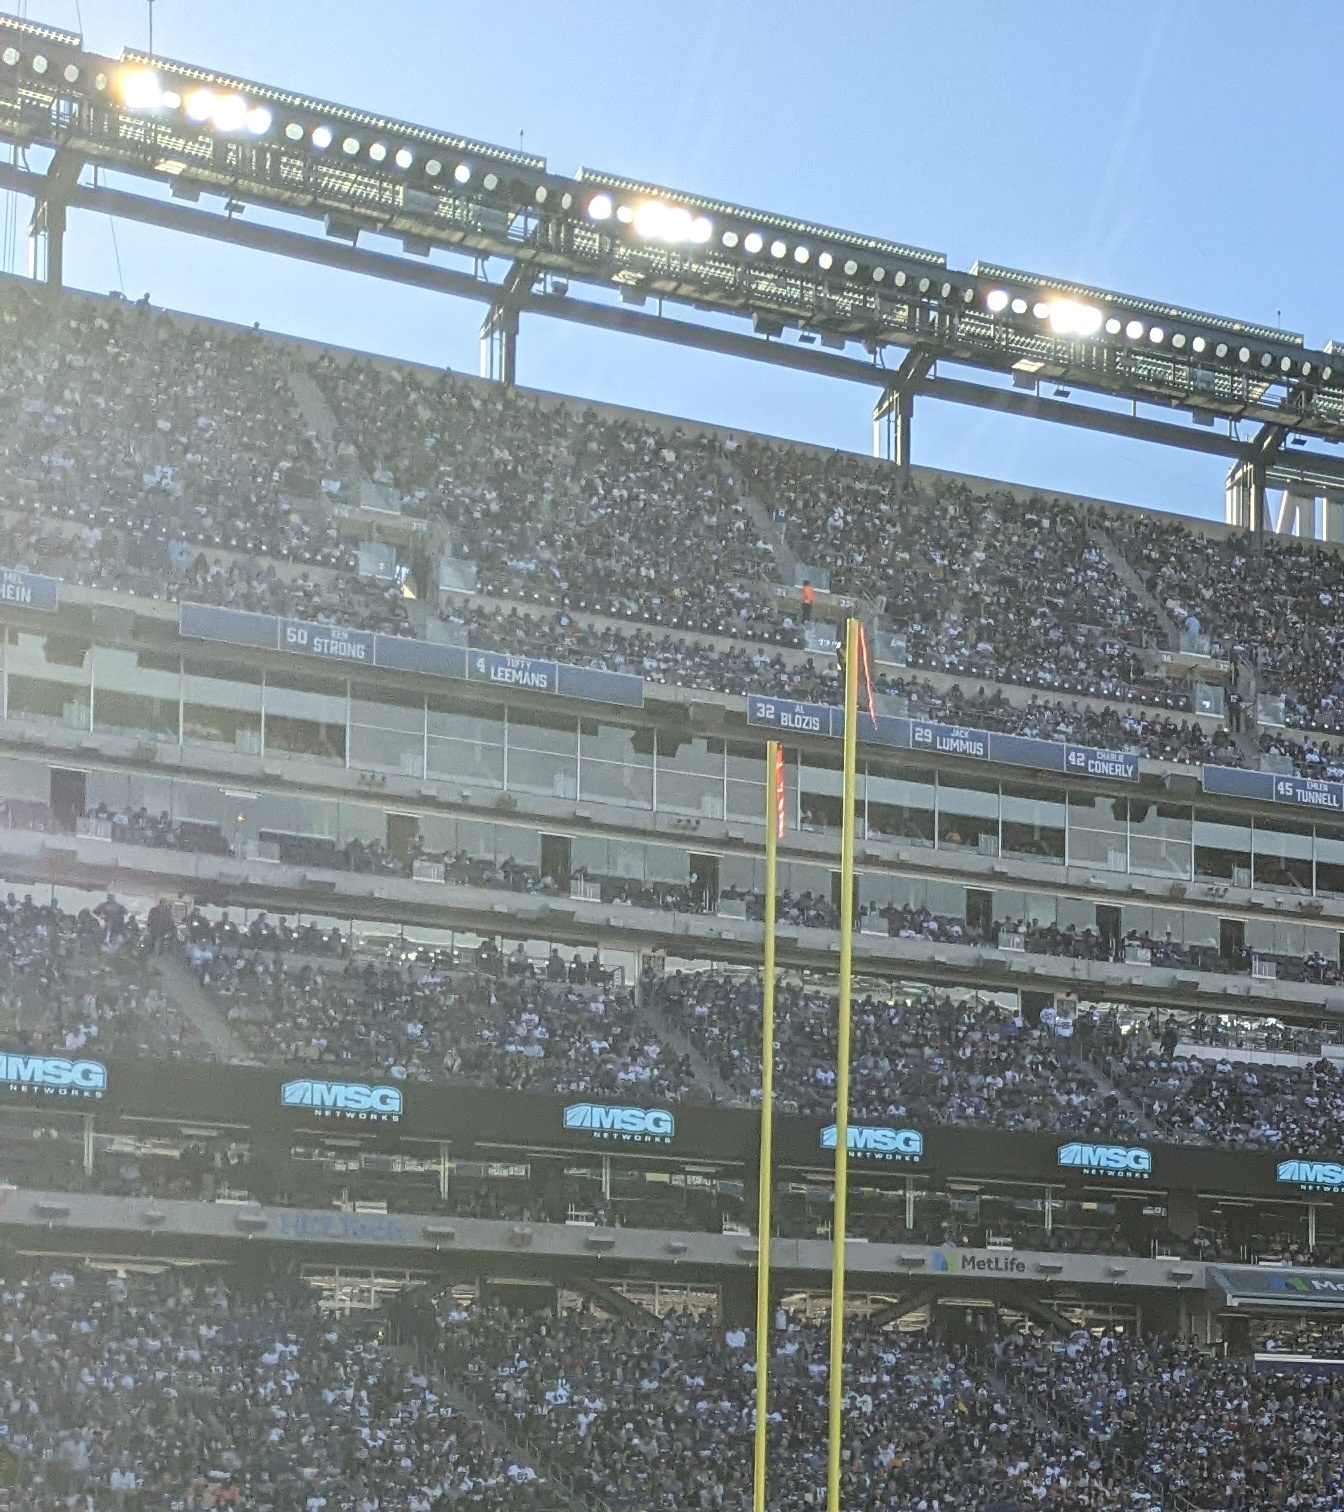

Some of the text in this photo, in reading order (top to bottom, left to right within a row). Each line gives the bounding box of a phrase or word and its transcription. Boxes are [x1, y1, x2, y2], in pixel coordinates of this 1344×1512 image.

[313, 638, 366, 660] STRONG
[476, 657, 486, 673] 4
[490, 668, 548, 688] LEEMANS
[756, 702, 775, 719] 32
[780, 713, 820, 731] BLOZIS
[914, 727, 932, 743] 29
[936, 736, 984, 756] LUMMUS
[1068, 751, 1086, 767] 42
[1087, 759, 1134, 778] CONERLY
[1277, 781, 1293, 795] 45
[1296, 788, 1340, 807] TUNNELL
[5, 1054, 105, 1089] MSG
[9, 1084, 103, 1099] NETWORKS
[309, 1081, 402, 1113] MSG
[313, 1109, 400, 1123] NETWORKS
[591, 1106, 674, 1135] MSG
[592, 1131, 672, 1144] NETWORKS
[846, 1126, 923, 1154] MSG
[847, 1150, 921, 1162] NETWORKS
[1081, 1144, 1151, 1173] MSG
[961, 1253, 1026, 1274] MetLife
